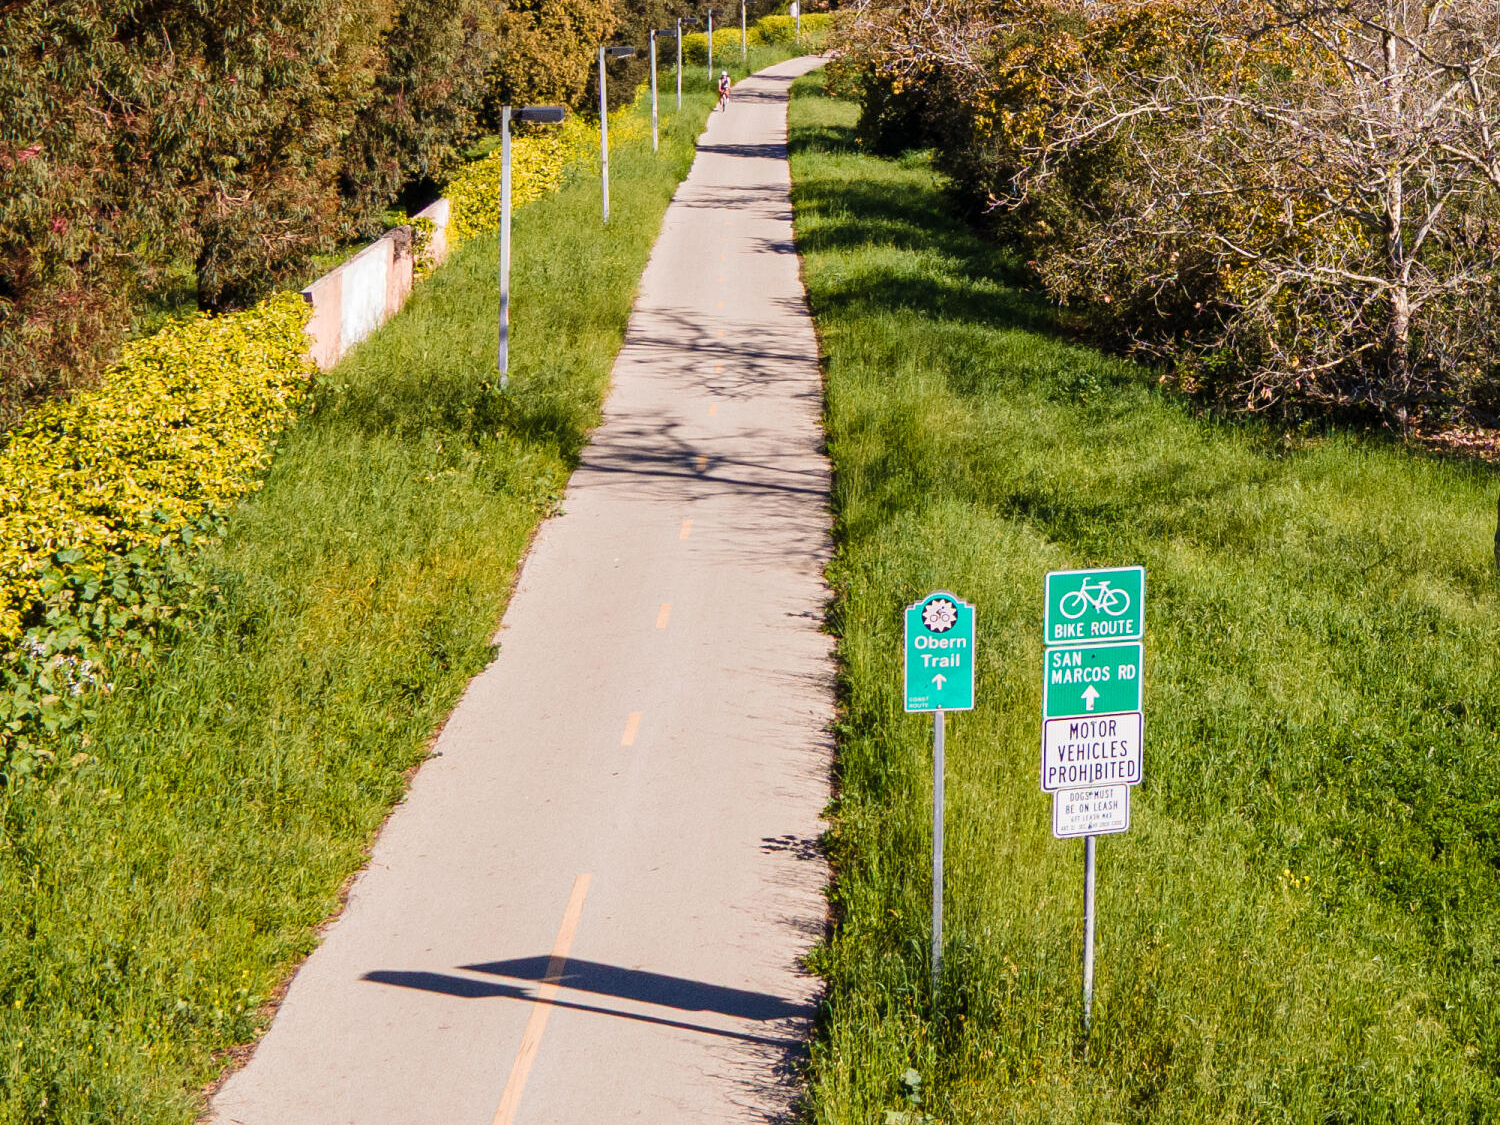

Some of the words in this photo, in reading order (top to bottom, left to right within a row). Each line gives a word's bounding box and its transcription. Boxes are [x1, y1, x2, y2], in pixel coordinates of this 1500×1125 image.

[1054, 622, 1084, 638] BIKE
[1091, 619, 1134, 636] ROUTE
[914, 635, 967, 650] Obern
[921, 653, 961, 668] Trail
[1052, 652, 1082, 667] SAN
[1051, 666, 1110, 684] MARCOS
[1118, 664, 1136, 680] RD
[1069, 719, 1116, 739] MOTOR
[1058, 740, 1128, 762] VEHICLES
[1049, 760, 1135, 784] PROHIBITED
[1070, 792, 1089, 802] DOGS
[1094, 789, 1113, 799] MUST
[1065, 805, 1075, 814] BE
[1079, 803, 1089, 813] ON
[1094, 800, 1118, 811] LEASH
